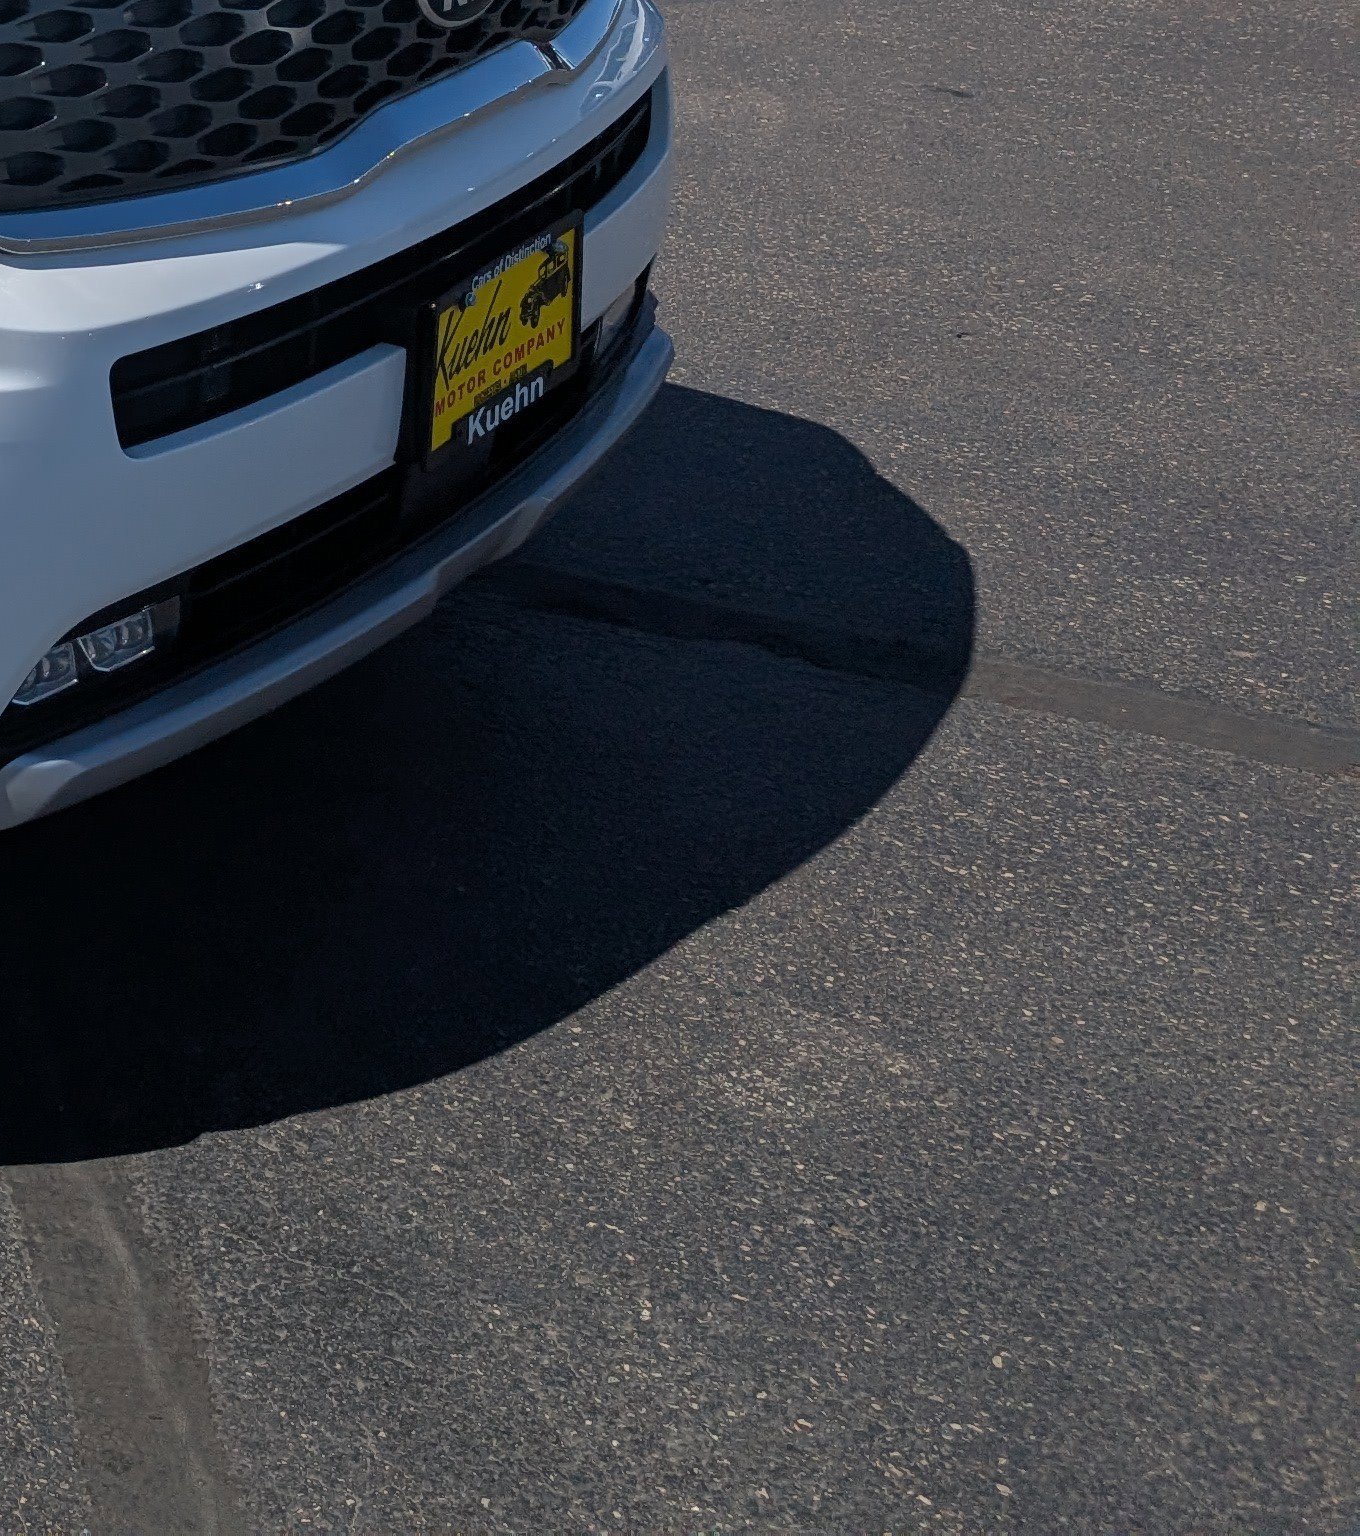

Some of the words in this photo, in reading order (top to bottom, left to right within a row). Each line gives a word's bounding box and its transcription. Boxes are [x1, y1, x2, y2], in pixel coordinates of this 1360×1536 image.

[472, 270, 492, 291] Cars
[494, 258, 504, 278] of
[505, 233, 552, 272] Distinction
[434, 368, 487, 417] MOTOR
[492, 317, 566, 377] COMPANY
[437, 279, 512, 392] Kuehn
[467, 375, 545, 445] Kuehn
